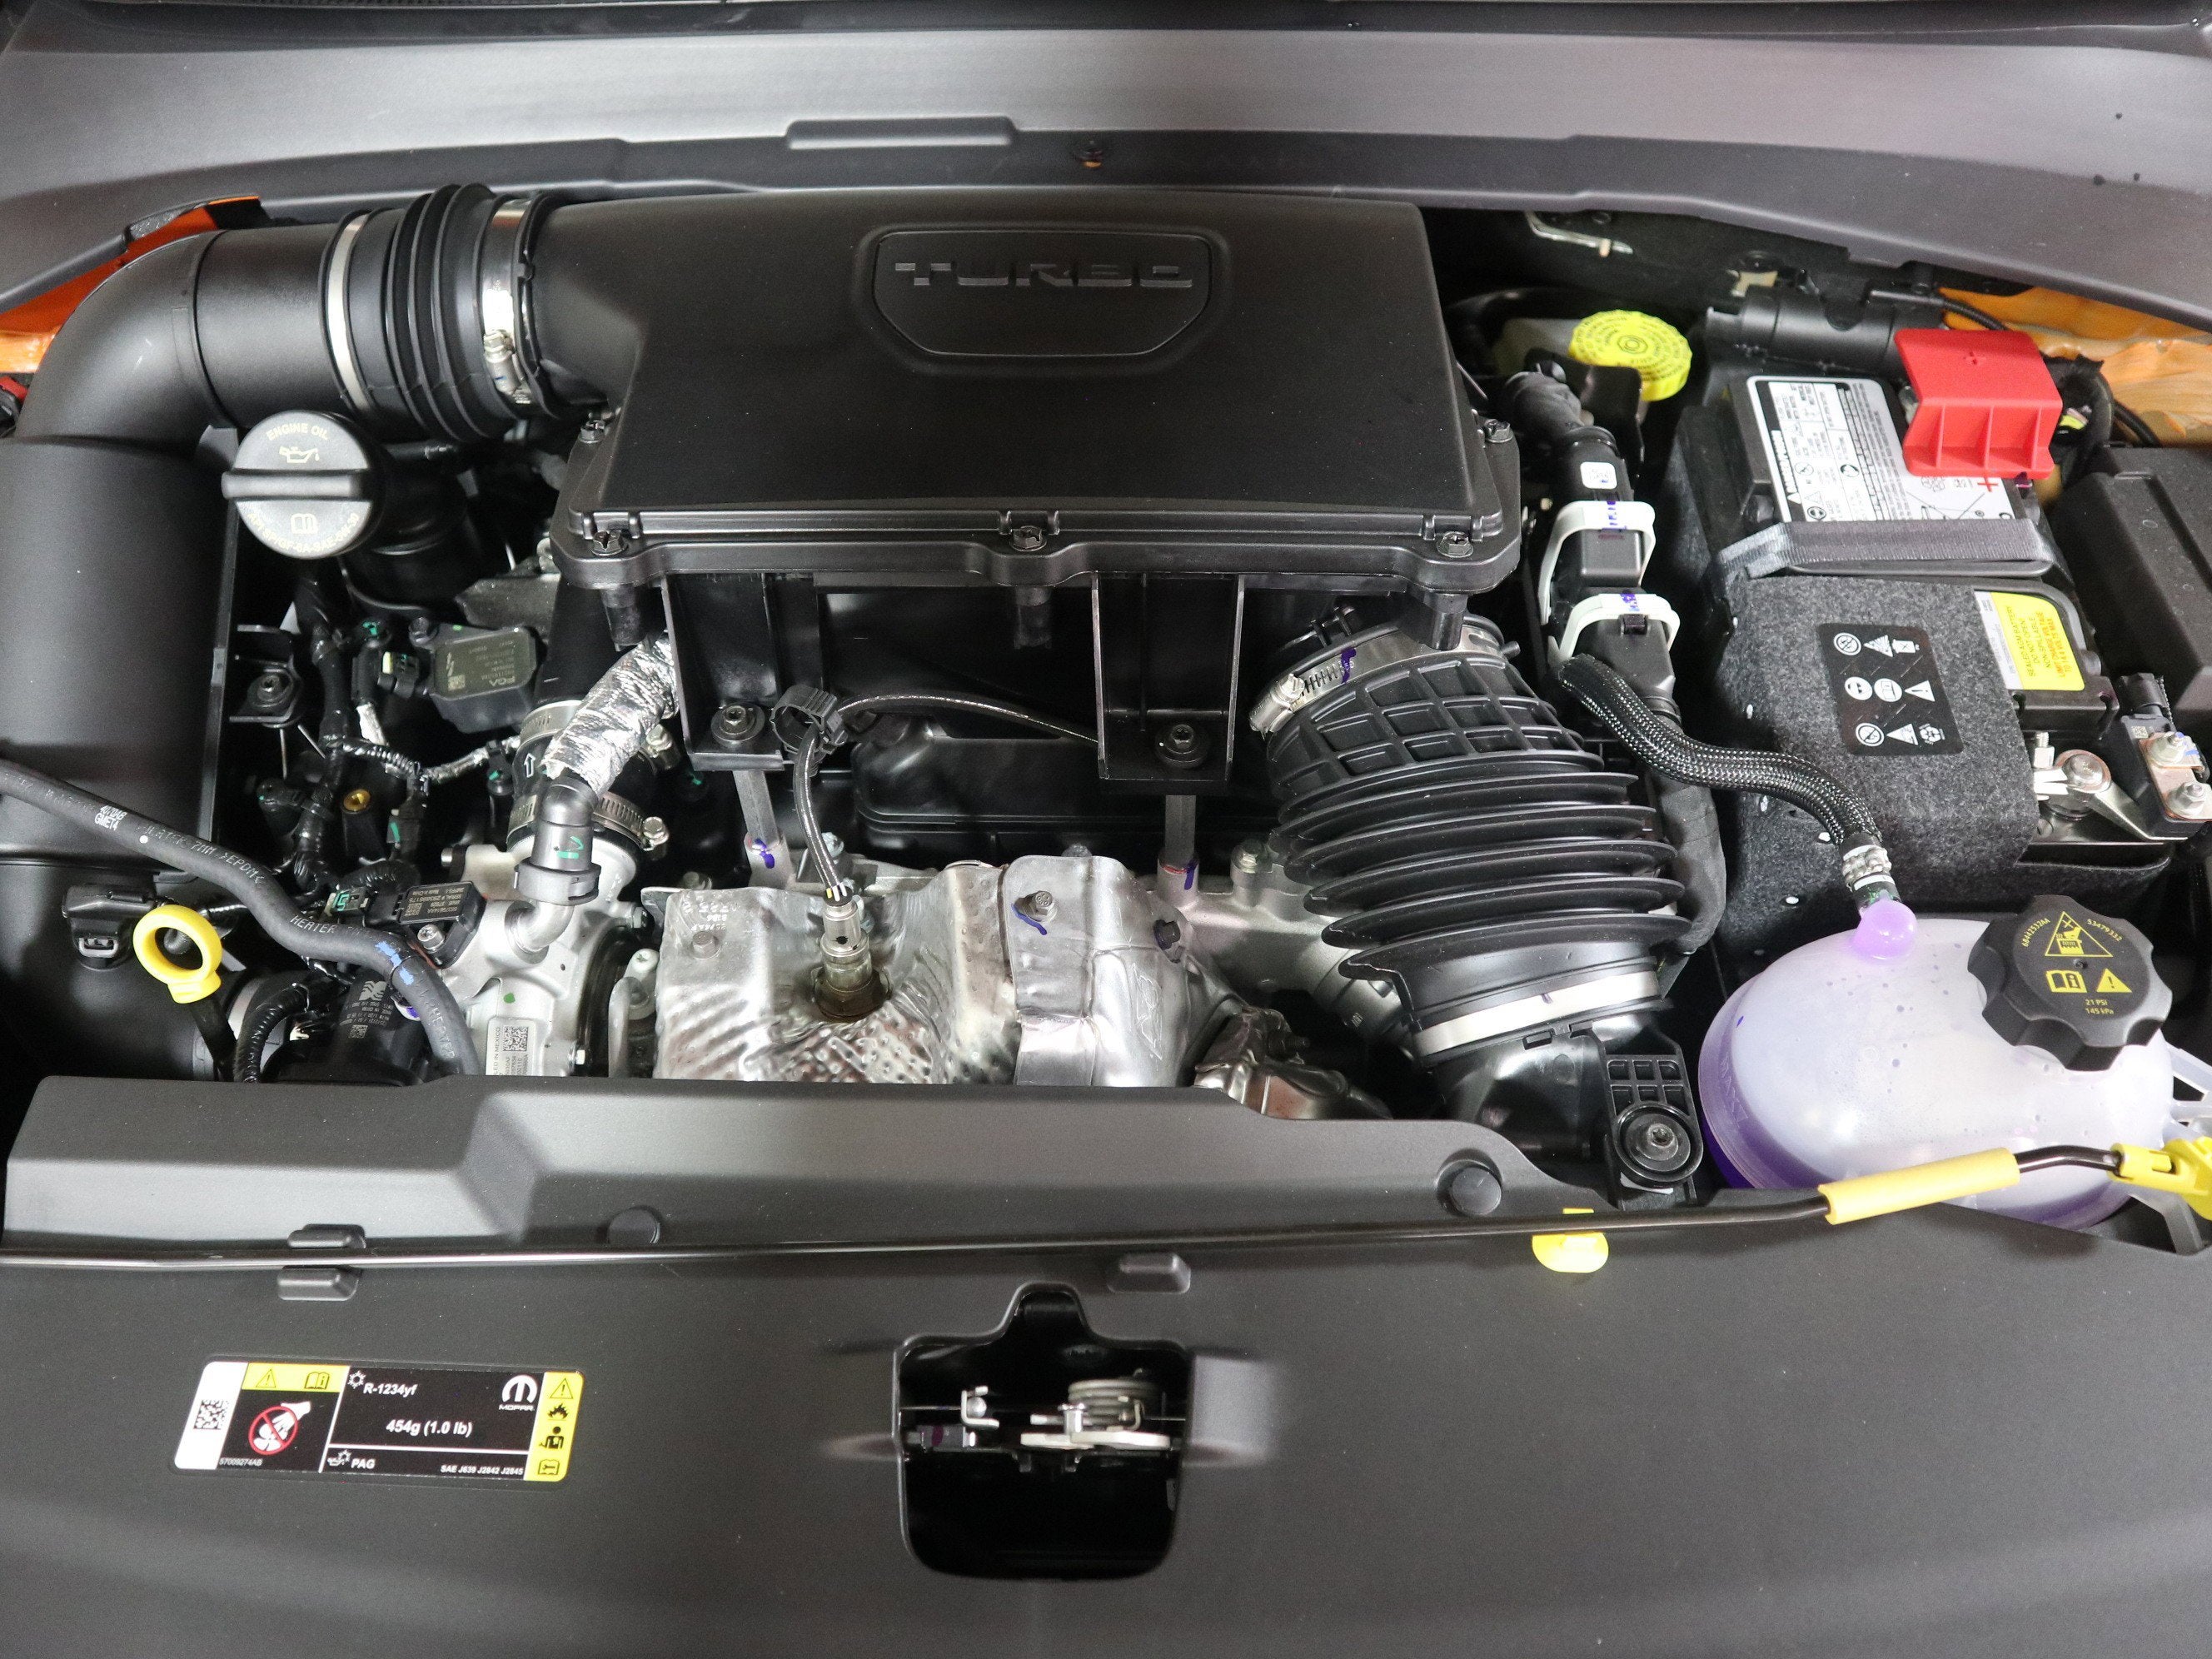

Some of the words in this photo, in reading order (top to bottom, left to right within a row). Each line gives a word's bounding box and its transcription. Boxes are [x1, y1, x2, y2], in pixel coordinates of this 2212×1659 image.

[266, 422, 309, 441] ENGINE
[311, 425, 331, 441] OIL
[290, 914, 336, 934] HEATER
[363, 1382, 418, 1398] R-1234yf
[498, 1403, 536, 1412] MOPAR
[385, 1418, 421, 1437] 454g
[423, 1420, 451, 1437] (1.0
[452, 1421, 473, 1438] lb)
[351, 1457, 376, 1469] PAG
[440, 1464, 457, 1473] SAE
[458, 1466, 477, 1474] J639
[477, 1467, 501, 1475] J2842
[501, 1467, 524, 1476] J2845
